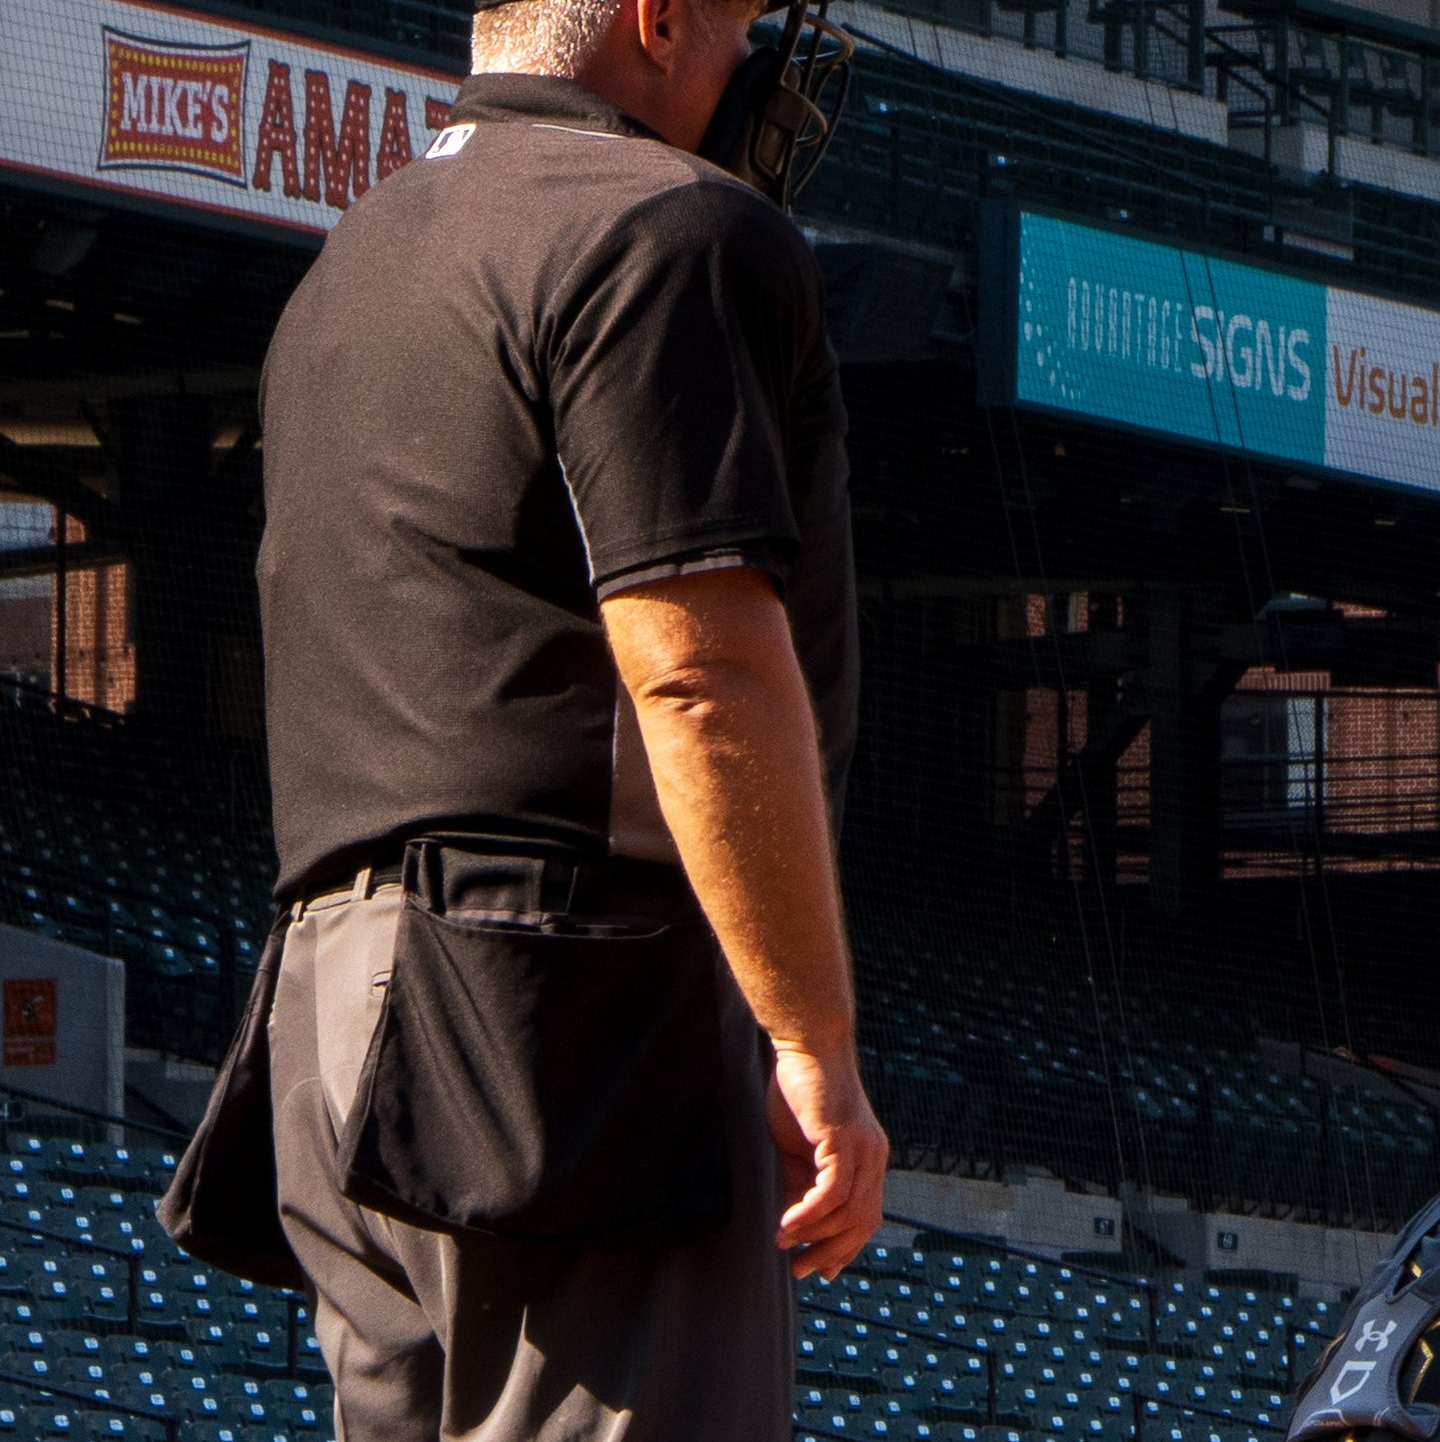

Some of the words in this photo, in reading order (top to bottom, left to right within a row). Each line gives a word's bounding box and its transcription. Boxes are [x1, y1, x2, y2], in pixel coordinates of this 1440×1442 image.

[121, 72, 229, 143] MIKE'S
[1067, 277, 1182, 372] ADVANTAGE
[1191, 305, 1311, 400] SIGNS
[1333, 344, 1439, 427] Visual
